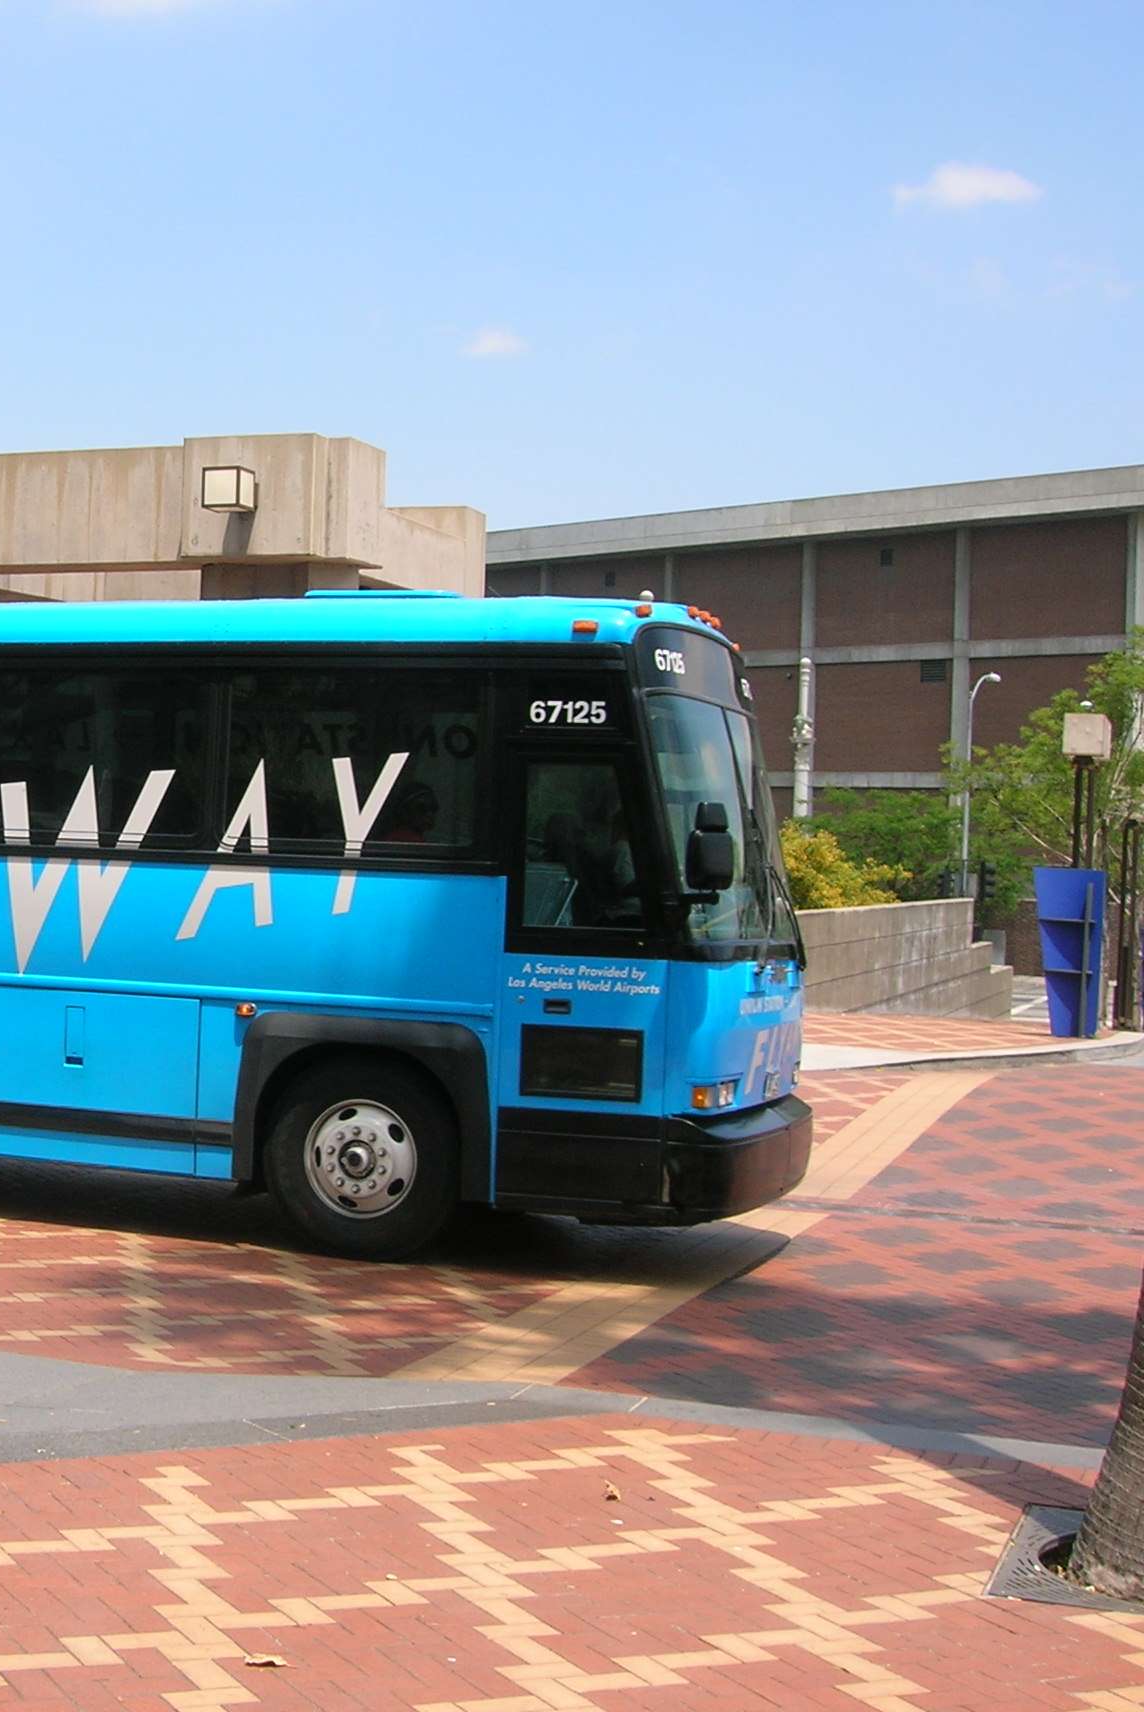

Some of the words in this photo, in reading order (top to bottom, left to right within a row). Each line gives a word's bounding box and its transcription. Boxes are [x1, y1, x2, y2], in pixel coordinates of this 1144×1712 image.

[529, 700, 607, 724] 67125
[522, 962, 532, 974] A
[535, 962, 575, 976] Service
[578, 965, 629, 979] Provided
[631, 968, 647, 982] by
[508, 976, 526, 988] Los
[528, 977, 573, 992] Angeles
[577, 980, 612, 993] World
[613, 983, 661, 996] Airports
